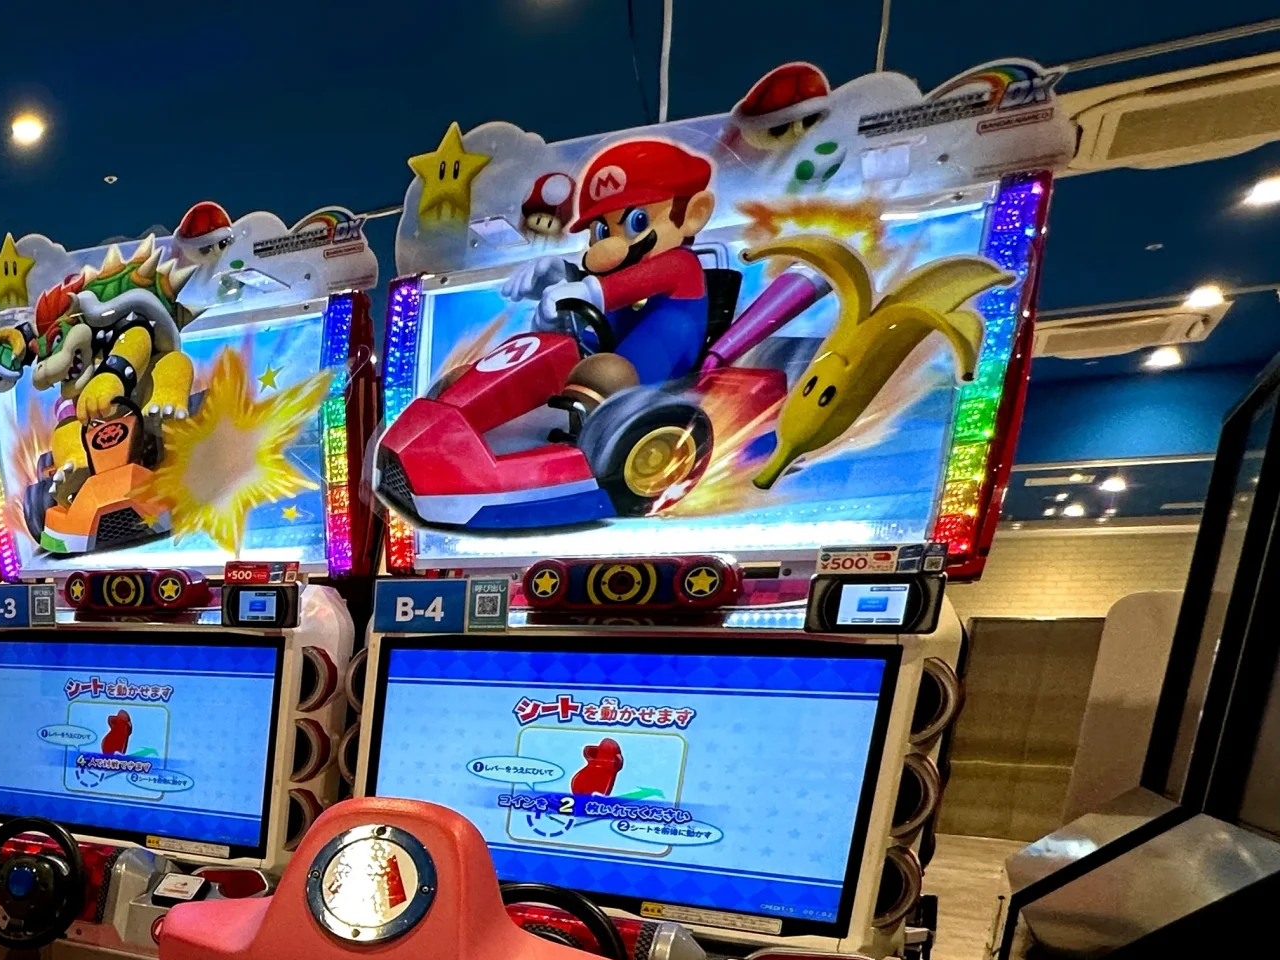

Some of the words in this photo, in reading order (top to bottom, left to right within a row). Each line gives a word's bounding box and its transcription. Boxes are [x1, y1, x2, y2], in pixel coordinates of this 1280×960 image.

[820, 557, 868, 570] ¥500
[395, 596, 445, 622] B-4
[64, 676, 174, 702] シートを動かせます
[512, 695, 696, 727] シートを動かせます
[497, 794, 549, 811] コインを
[559, 796, 575, 814] 2
[584, 801, 693, 823] 枚いれてください
